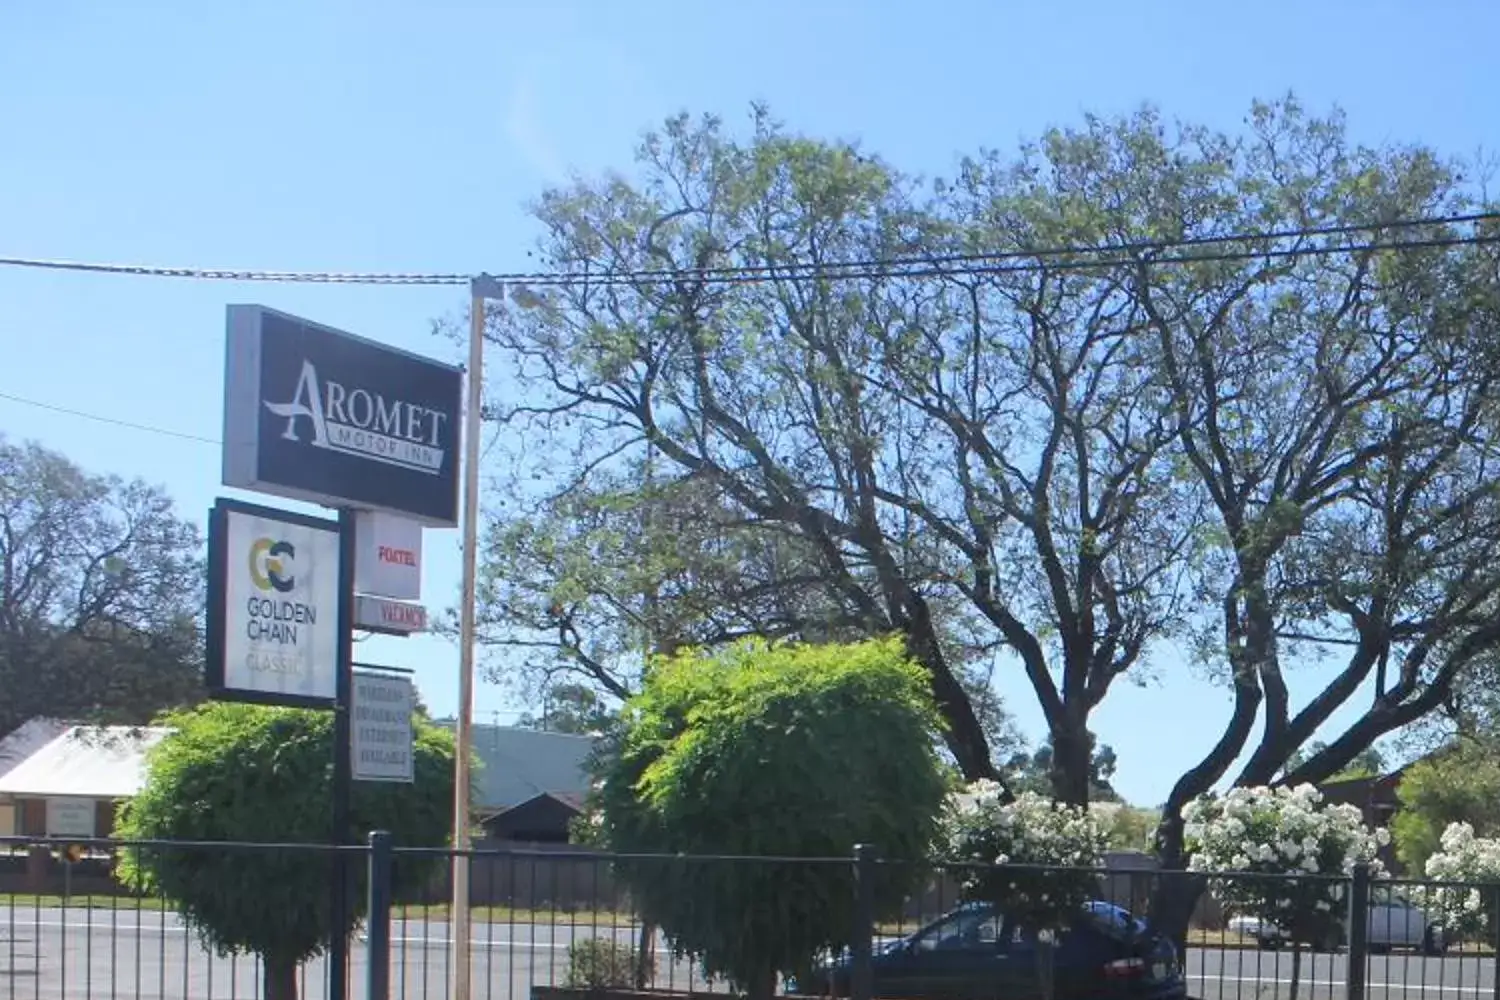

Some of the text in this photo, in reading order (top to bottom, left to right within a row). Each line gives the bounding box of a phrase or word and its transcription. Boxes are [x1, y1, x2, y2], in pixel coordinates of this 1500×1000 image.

[263, 359, 447, 447] AROMET
[338, 429, 433, 464] MOTOR INN
[247, 597, 316, 625] GOLDEN
[247, 619, 297, 646] CHAIN
